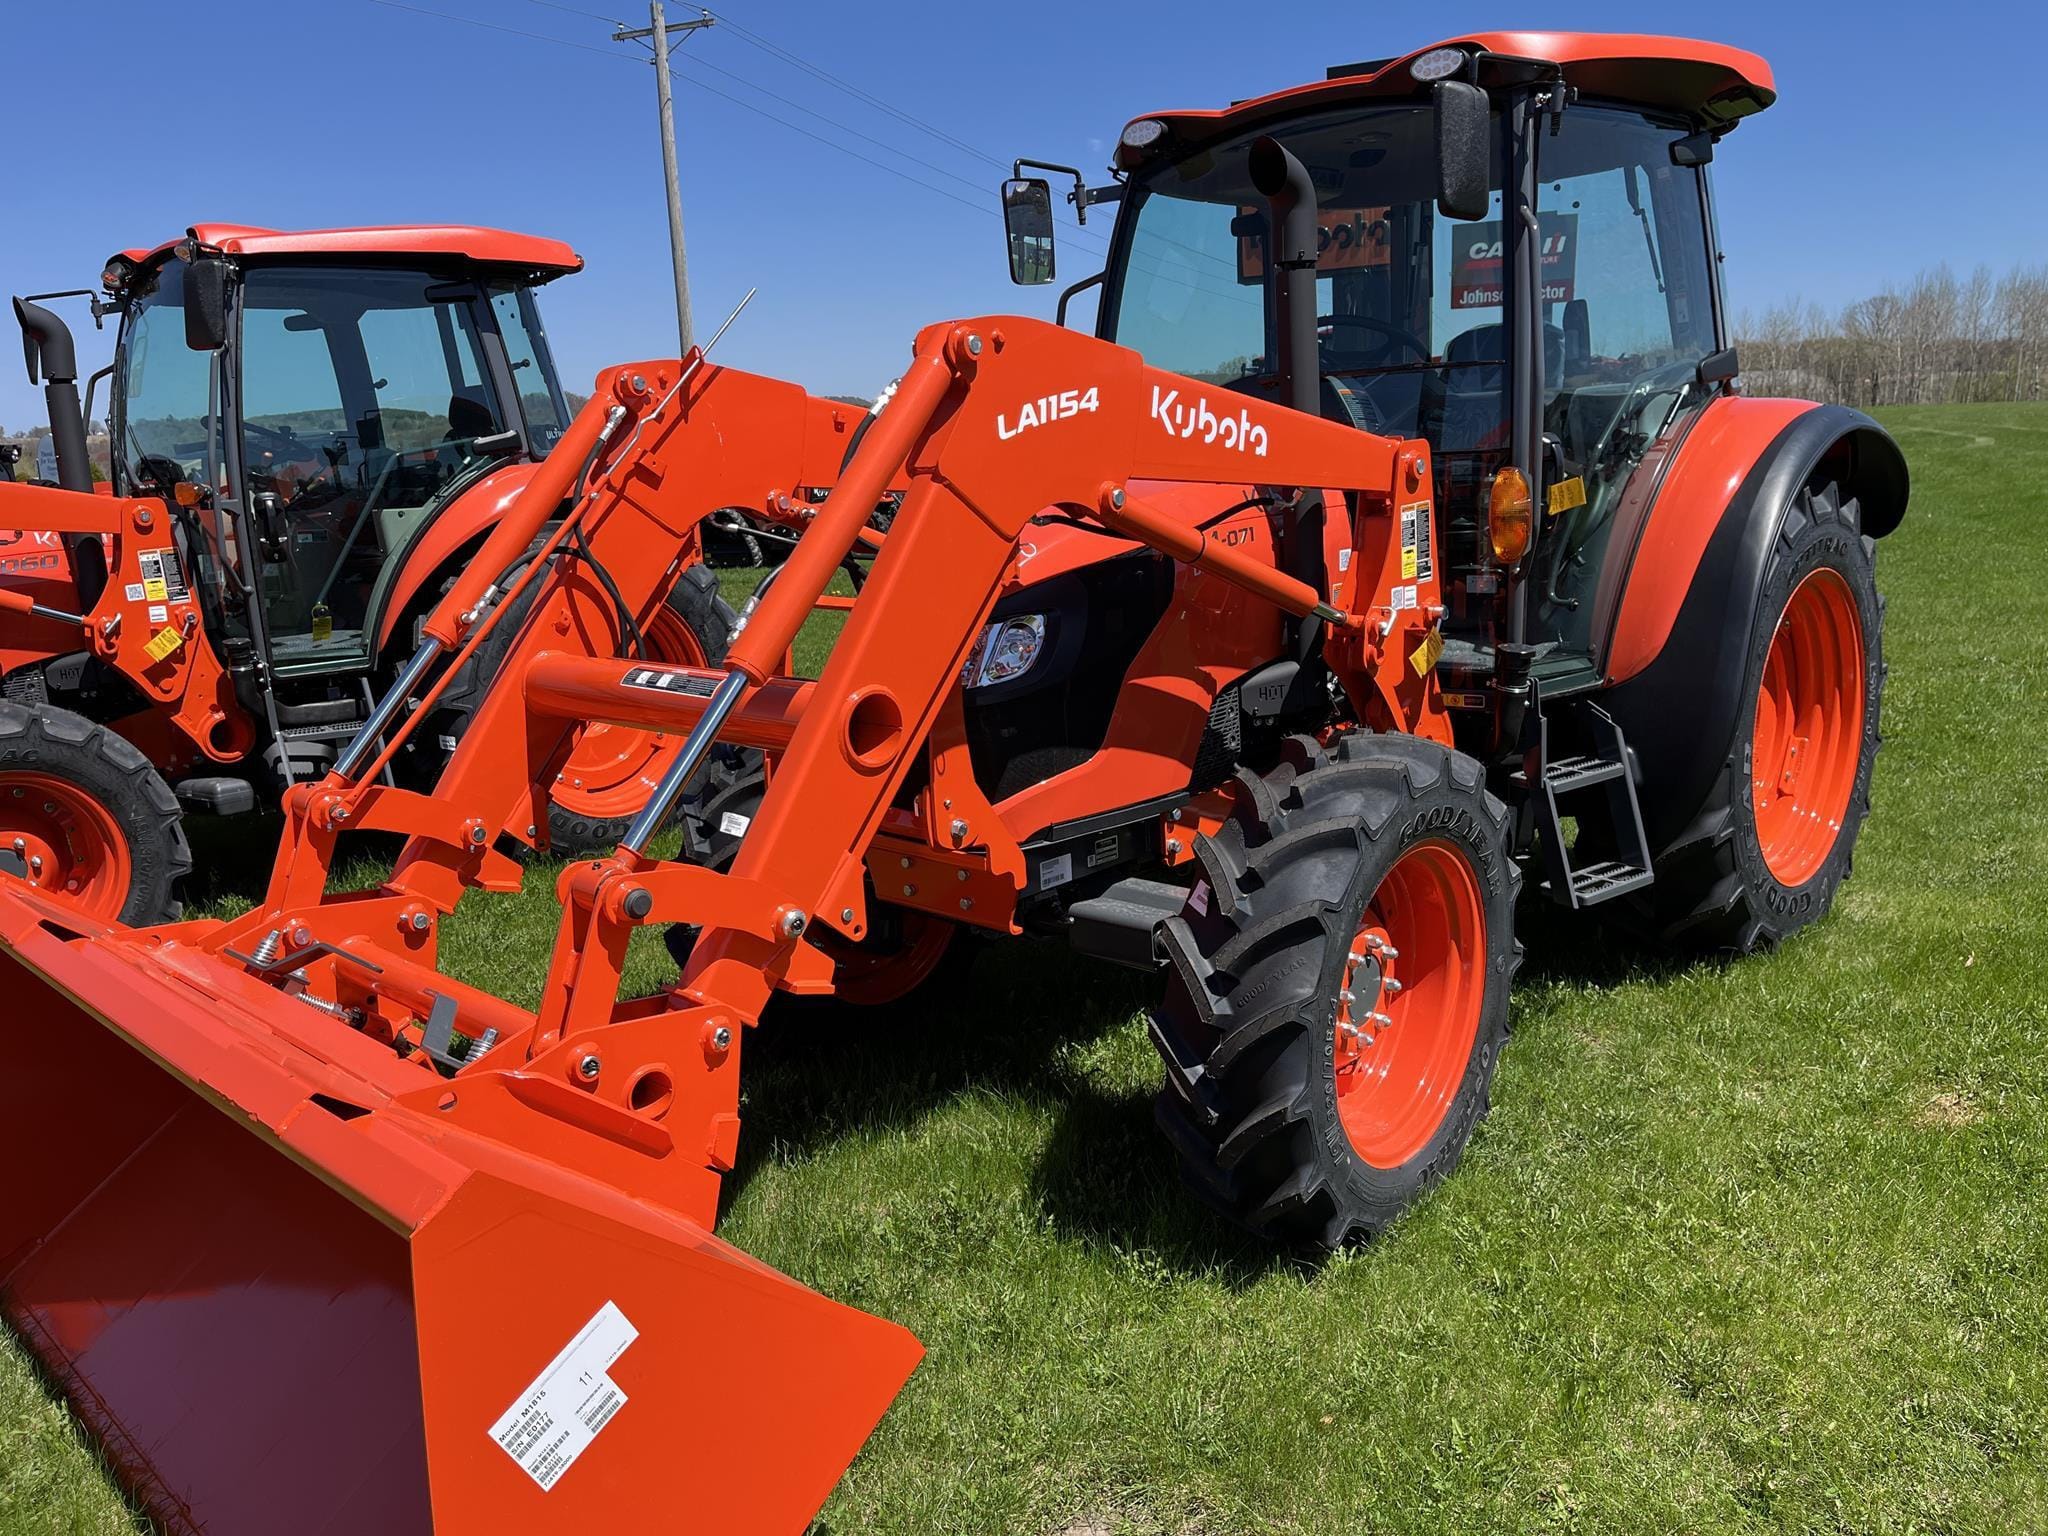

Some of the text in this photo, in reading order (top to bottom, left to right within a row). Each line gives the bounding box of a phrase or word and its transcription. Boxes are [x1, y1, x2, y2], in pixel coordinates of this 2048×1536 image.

[997, 386, 1100, 440] LA1154
[1151, 385, 1269, 457] Kubota
[1259, 684, 1287, 701] HOT
[578, 1370, 593, 1386] 11
[498, 1389, 547, 1443] Model M1815
[511, 1410, 550, 1455] S/N E0177
